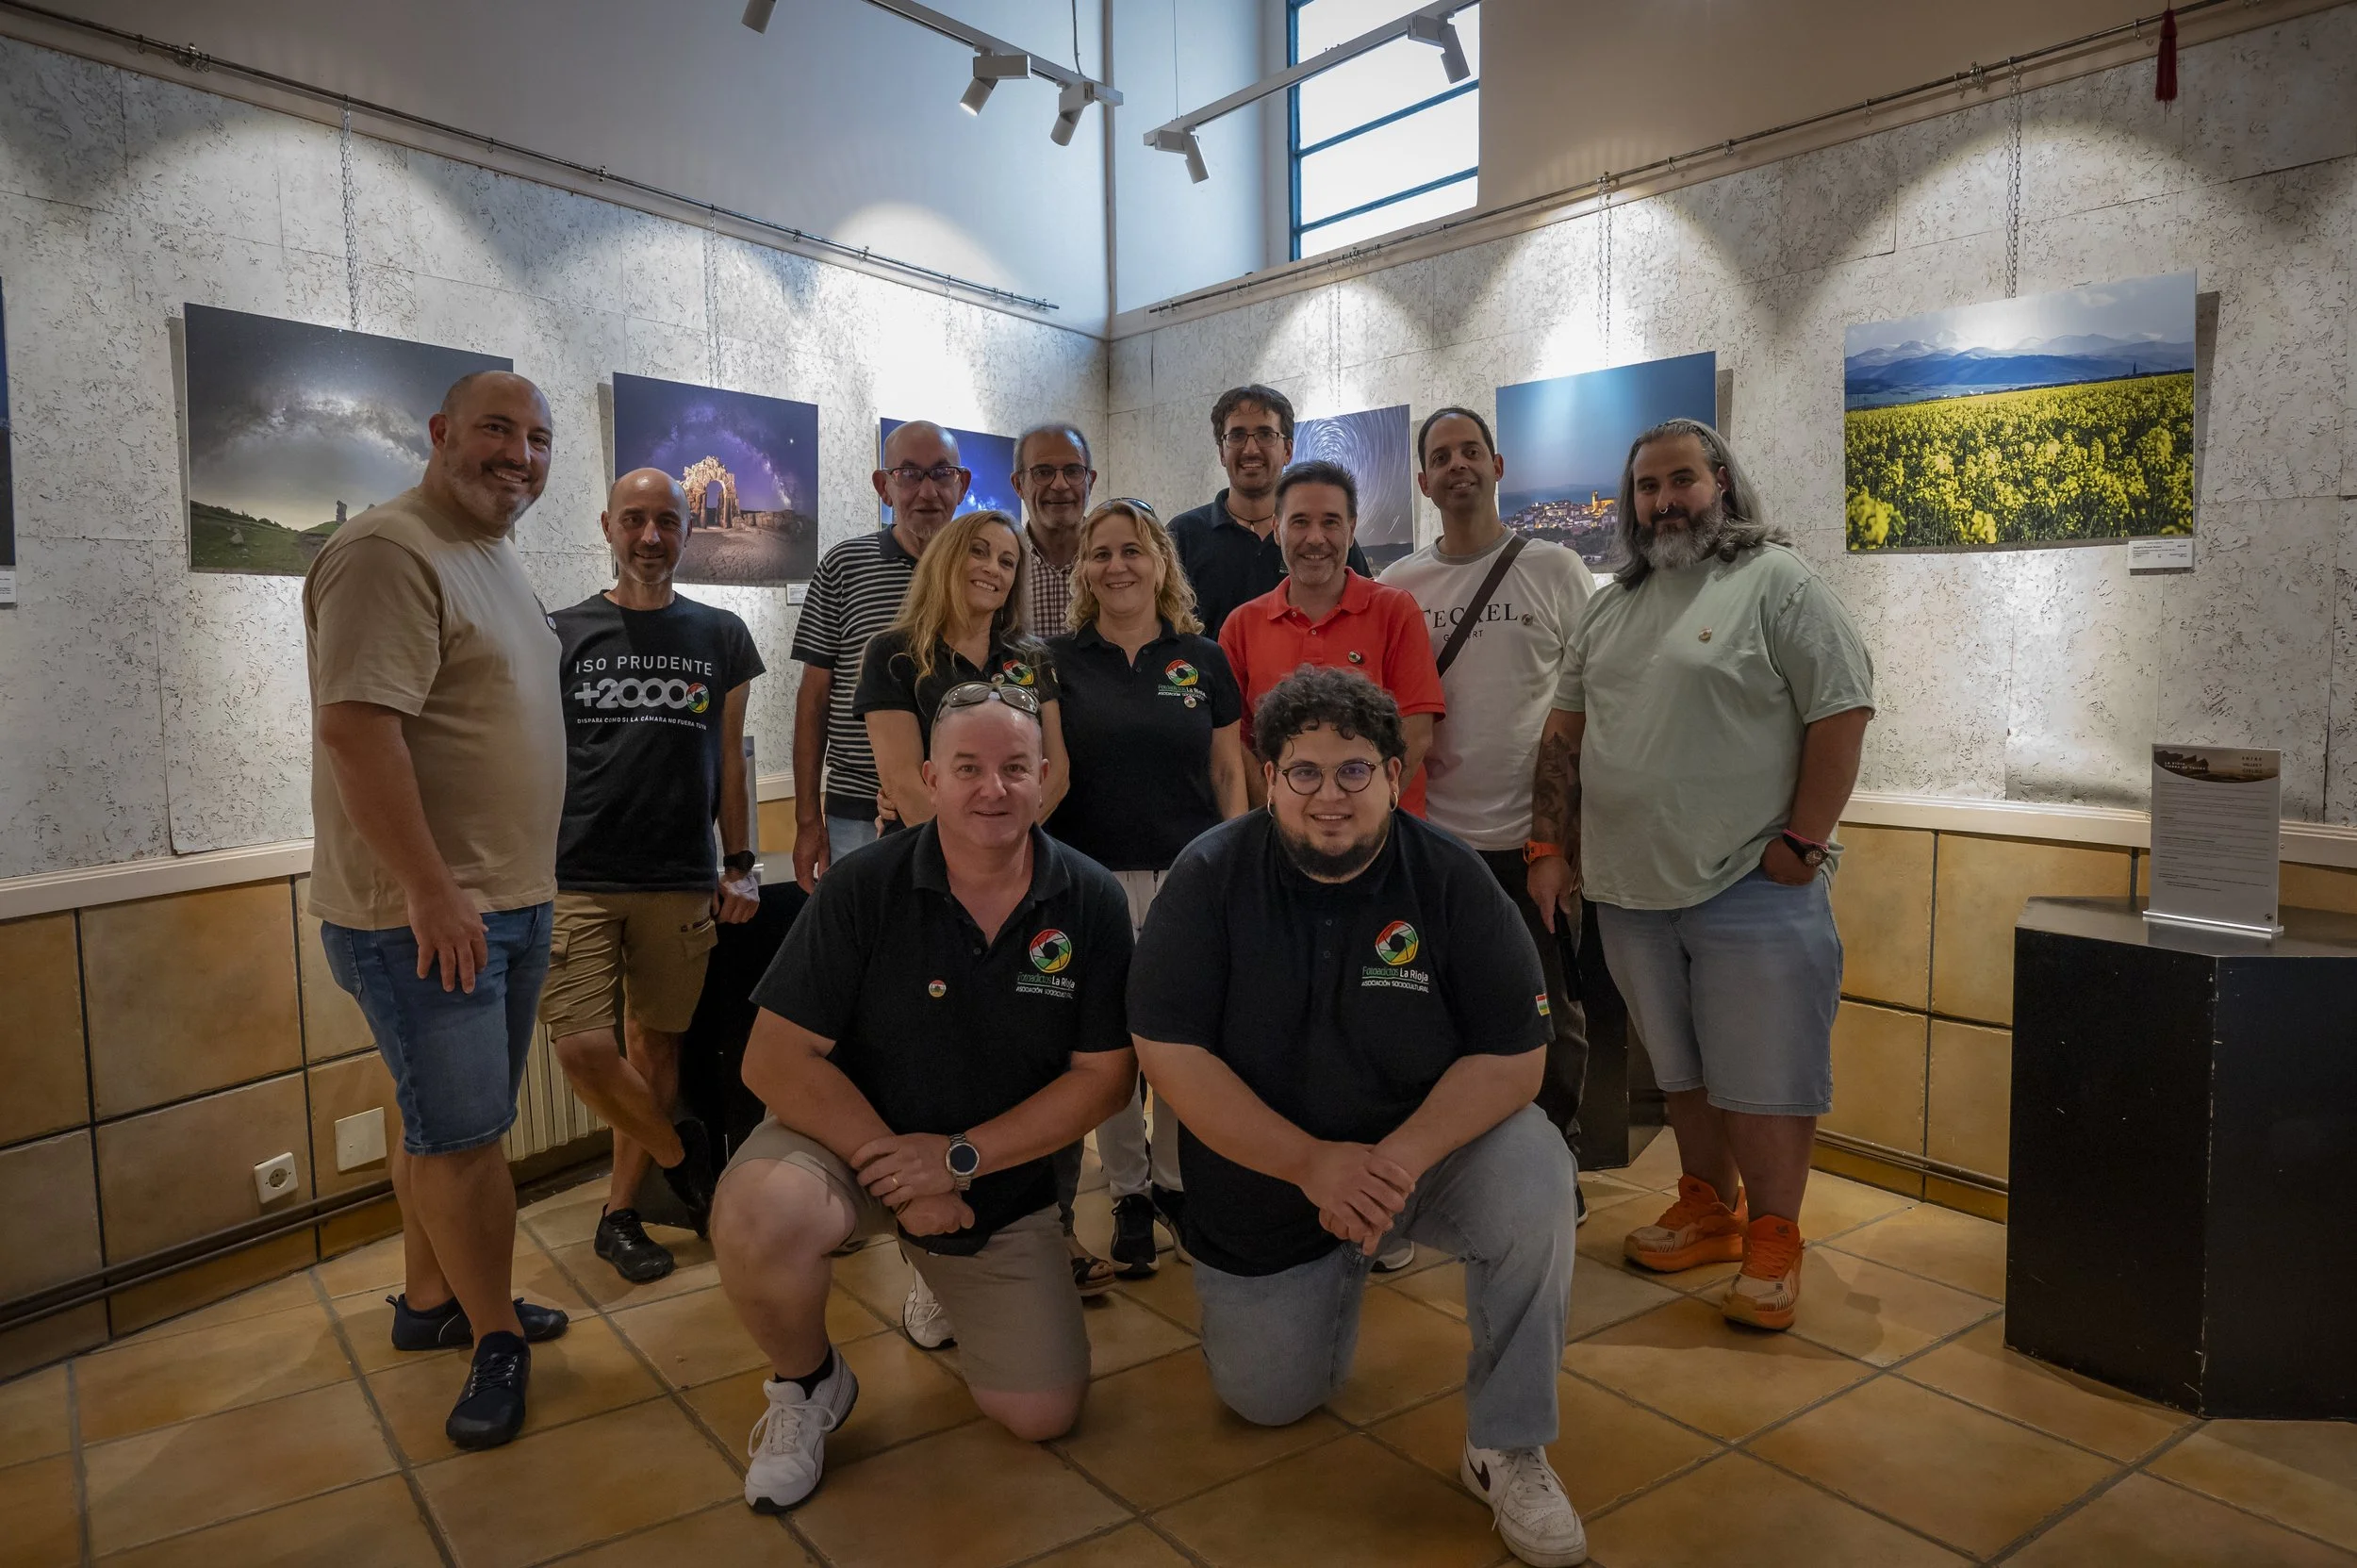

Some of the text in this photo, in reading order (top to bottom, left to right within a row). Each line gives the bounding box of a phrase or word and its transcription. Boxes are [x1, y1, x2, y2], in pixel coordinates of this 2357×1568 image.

[1423, 603, 1518, 628] ECEL
[575, 655, 713, 677] ISO PRUDENTE
[641, 715, 667, 723] CÁMARA
[1052, 975, 1060, 985] La
[1399, 967, 1409, 978] La
[1409, 969, 1428, 982] Rioja
